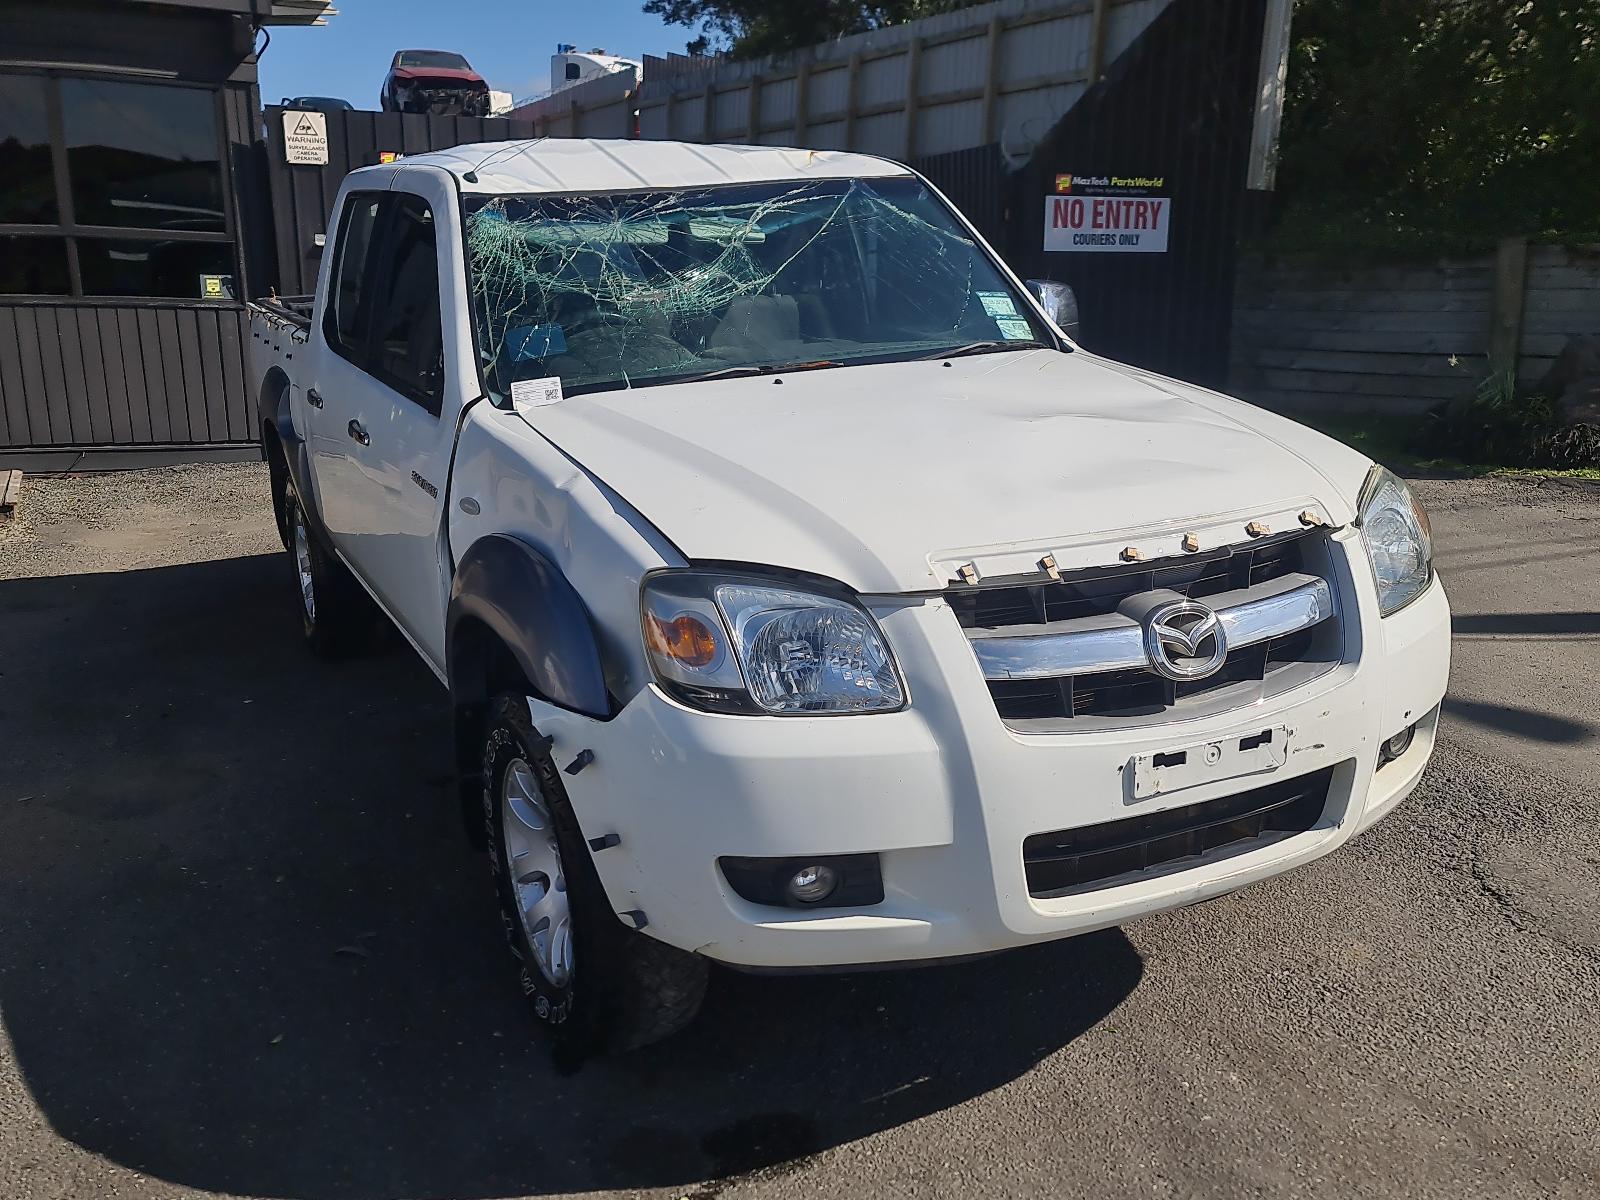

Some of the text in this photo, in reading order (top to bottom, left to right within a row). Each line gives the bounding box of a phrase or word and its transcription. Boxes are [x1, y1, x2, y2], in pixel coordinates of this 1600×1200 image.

[286, 136, 326, 144] WARNING
[1111, 177, 1164, 187] PartsWorld
[1052, 199, 1162, 230] NO ENTRY
[1072, 233, 1140, 246] COURIERS ONLY
